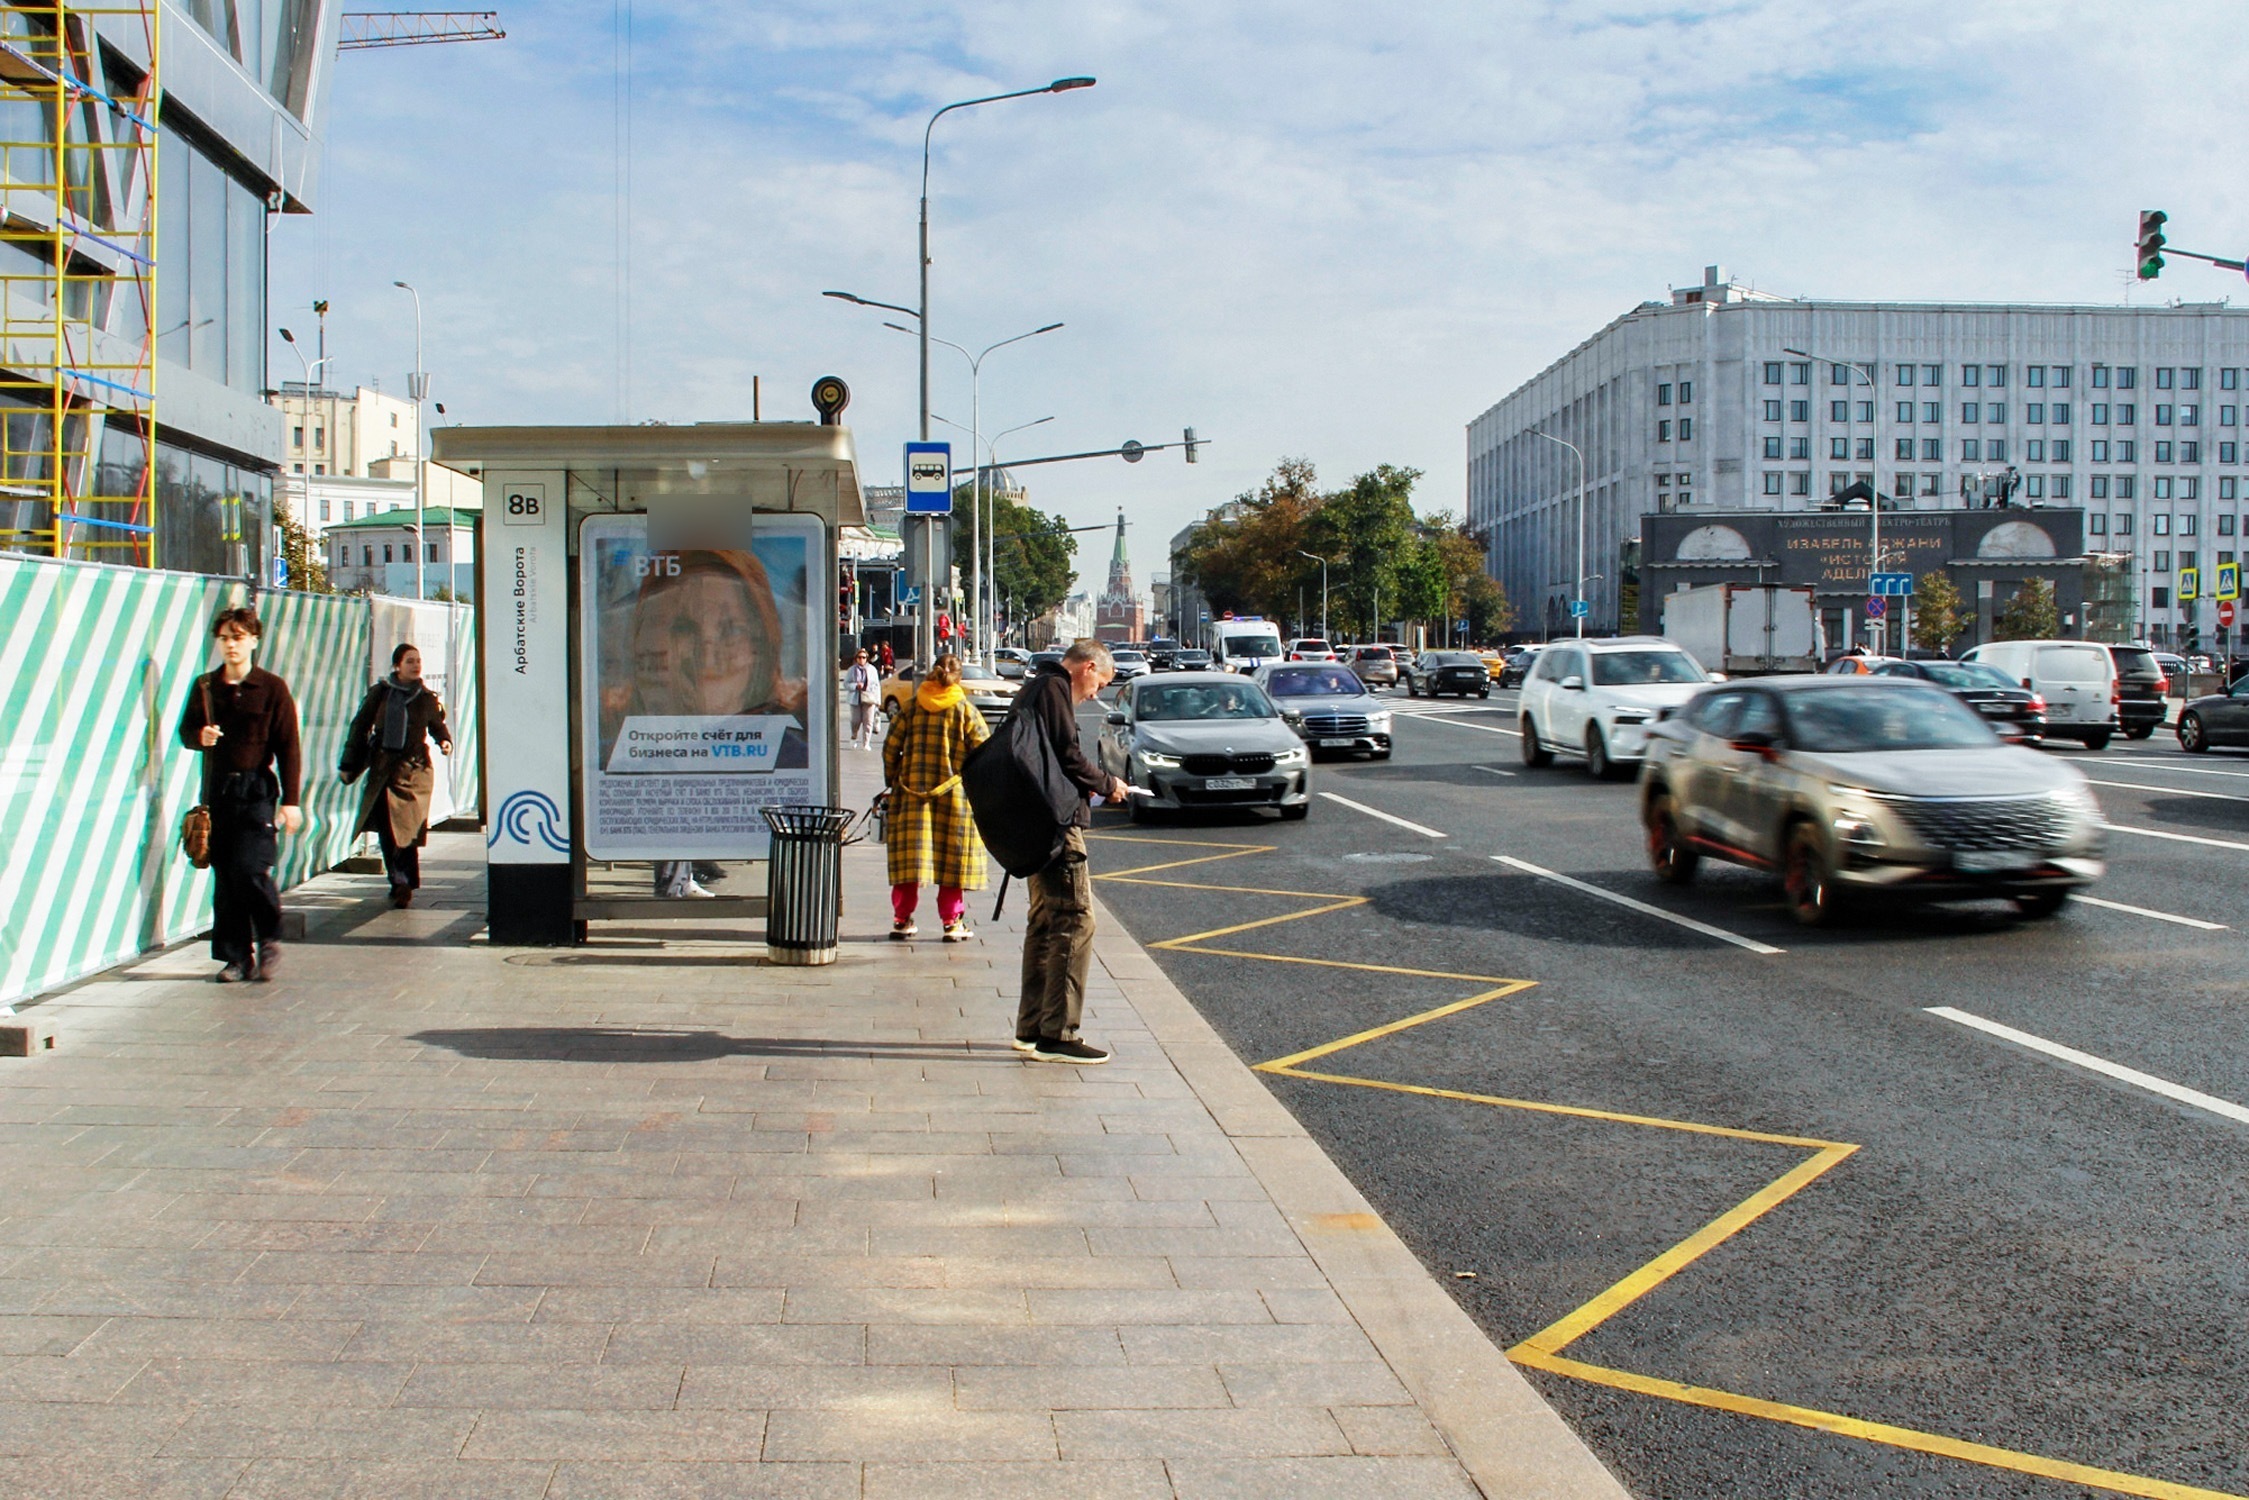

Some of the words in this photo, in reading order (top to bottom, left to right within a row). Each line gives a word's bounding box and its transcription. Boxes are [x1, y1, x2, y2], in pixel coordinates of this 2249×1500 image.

[1870, 516, 1951, 528] ЕКТРО-ТЕАТРЪ
[513, 546, 528, 597] Ворота
[634, 554, 682, 577] ВТБ
[513, 601, 529, 675] Арбатские
[628, 729, 699, 743] Откройте
[701, 728, 733, 741] счёт
[734, 731, 763, 742] для
[628, 746, 688, 758] бизнеса
[690, 749, 709, 758] на
[711, 744, 768, 758] VTB.RU
